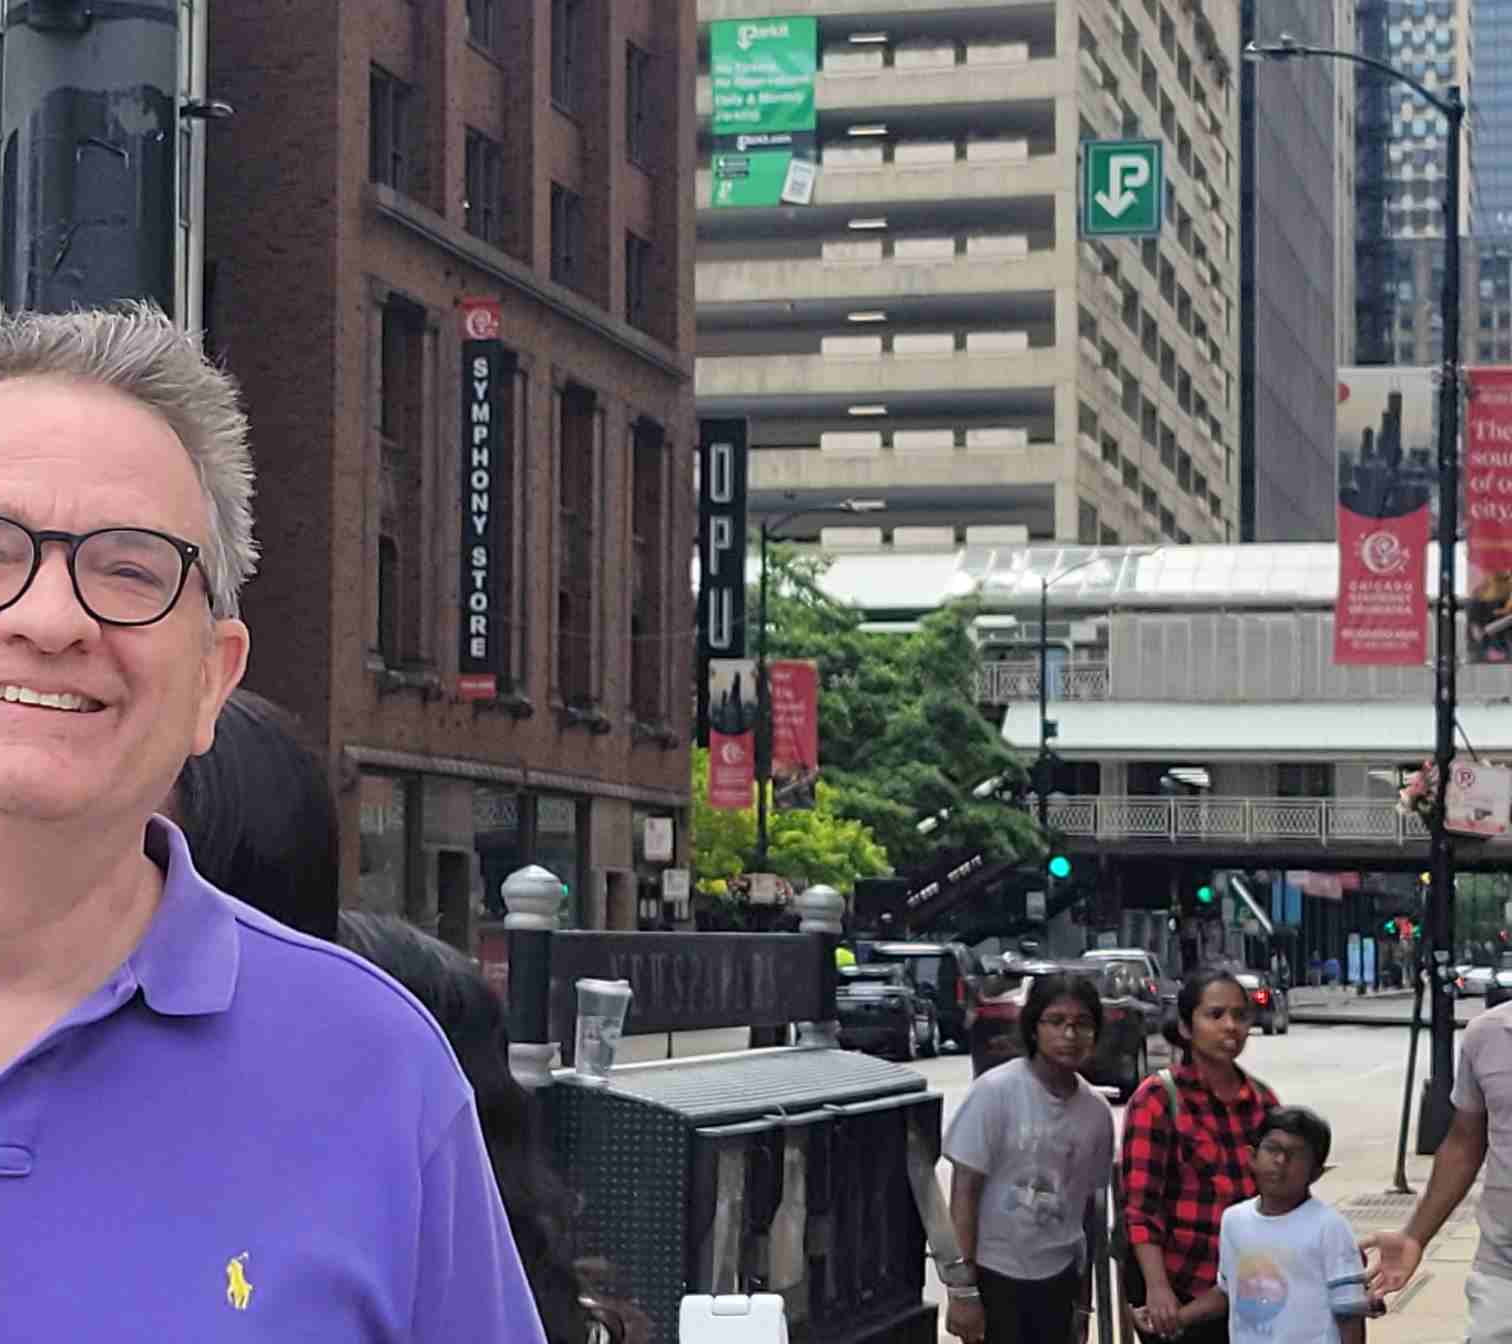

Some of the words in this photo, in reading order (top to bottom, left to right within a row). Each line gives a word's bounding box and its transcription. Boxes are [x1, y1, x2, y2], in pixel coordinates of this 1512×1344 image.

[470, 356, 491, 535] SYMPHONY
[469, 546, 489, 657] STORE
[708, 442, 735, 650] OPU
